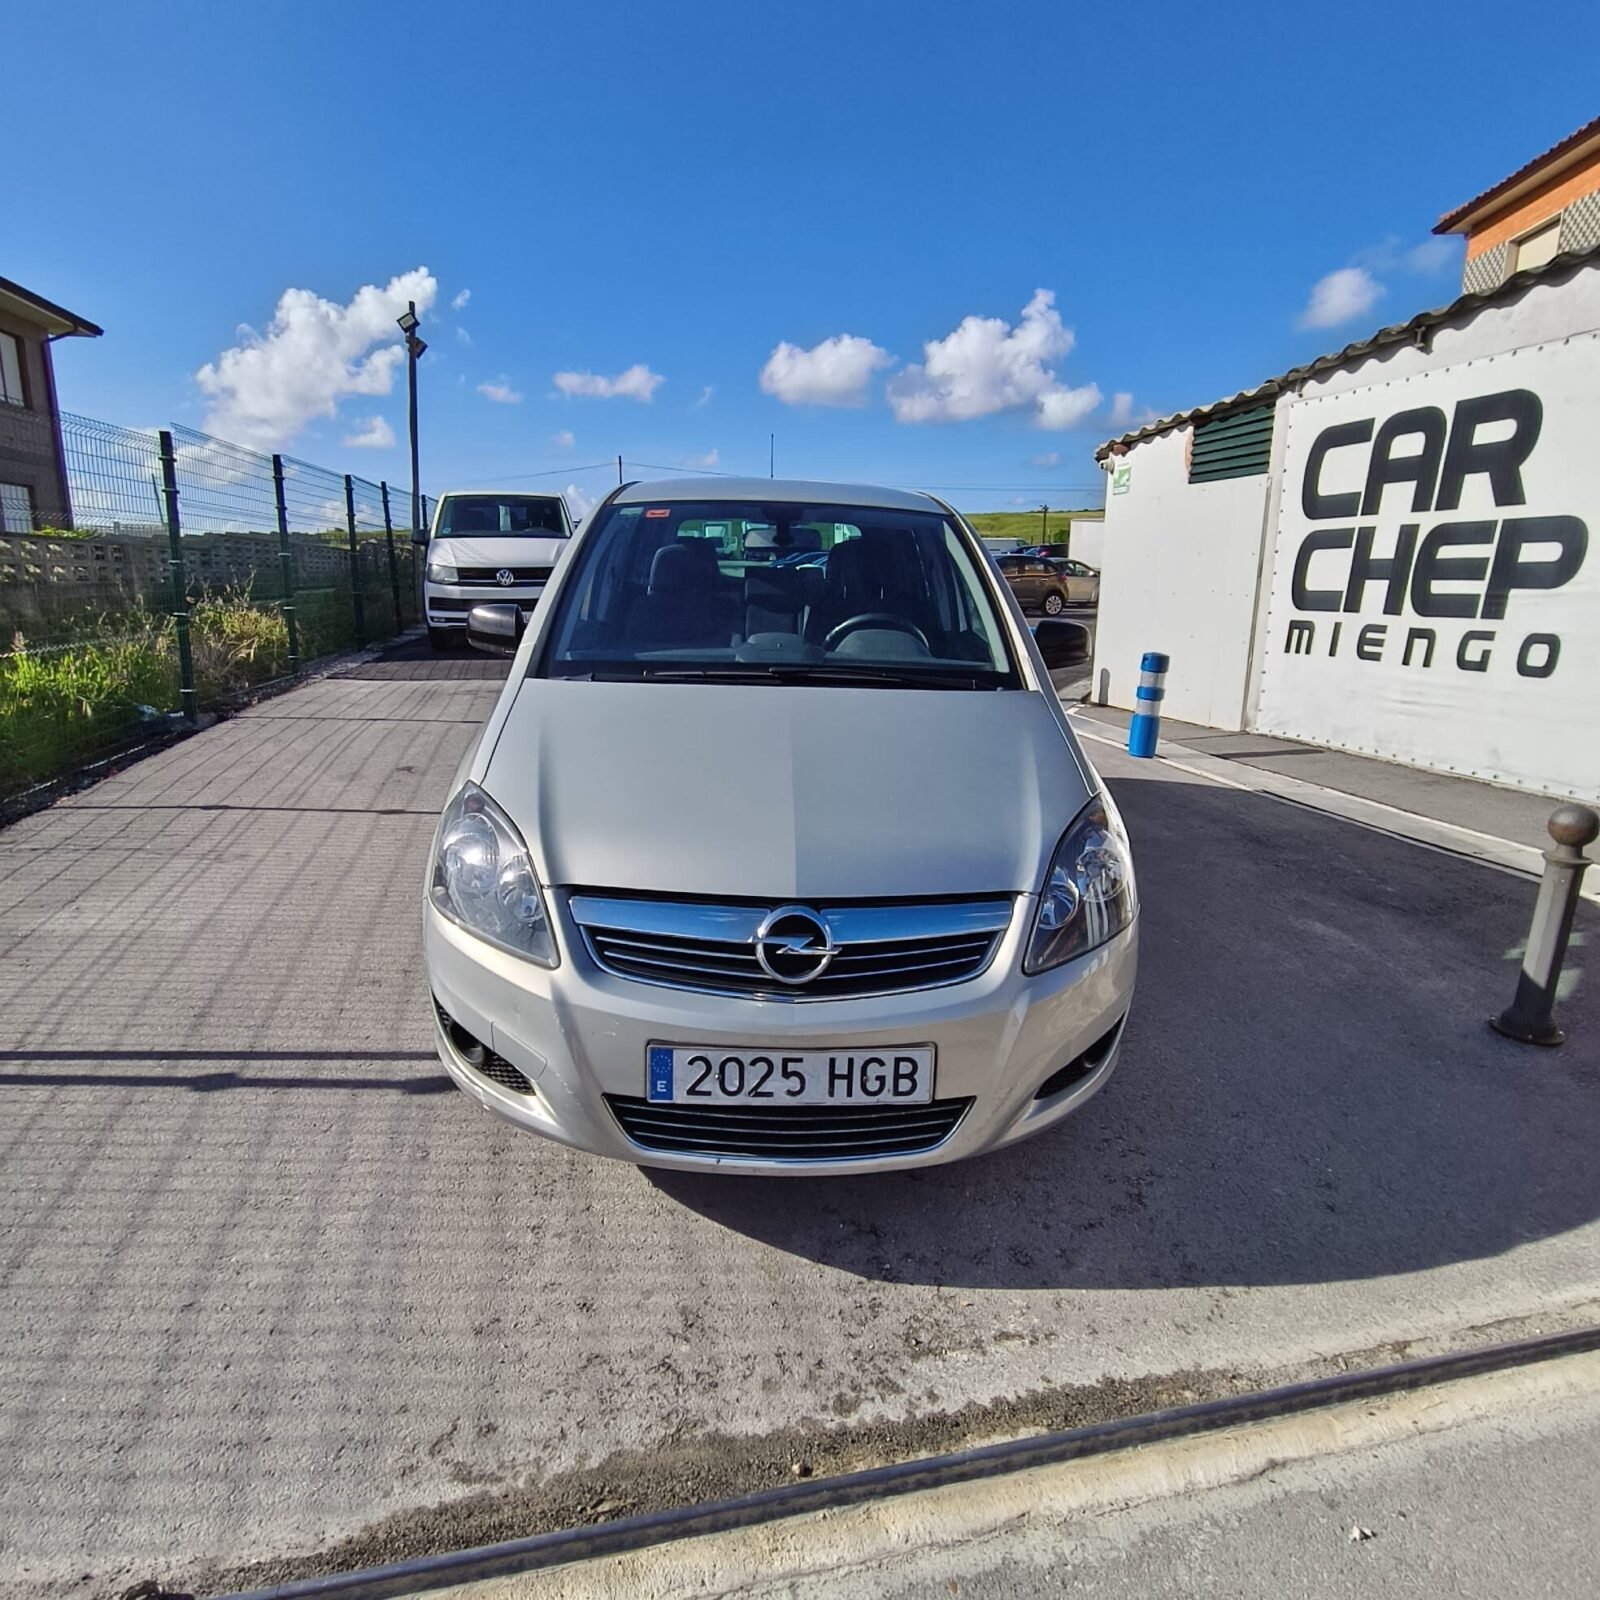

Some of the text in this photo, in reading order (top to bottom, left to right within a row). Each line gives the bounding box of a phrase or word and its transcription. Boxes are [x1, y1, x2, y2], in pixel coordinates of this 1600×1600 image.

[1301, 388, 1544, 521] CAR
[1291, 515, 1589, 620] CHEP
[1284, 619, 1561, 679] MIENGO
[656, 1080, 667, 1092] E
[685, 1055, 919, 1098] 2025 HGB
